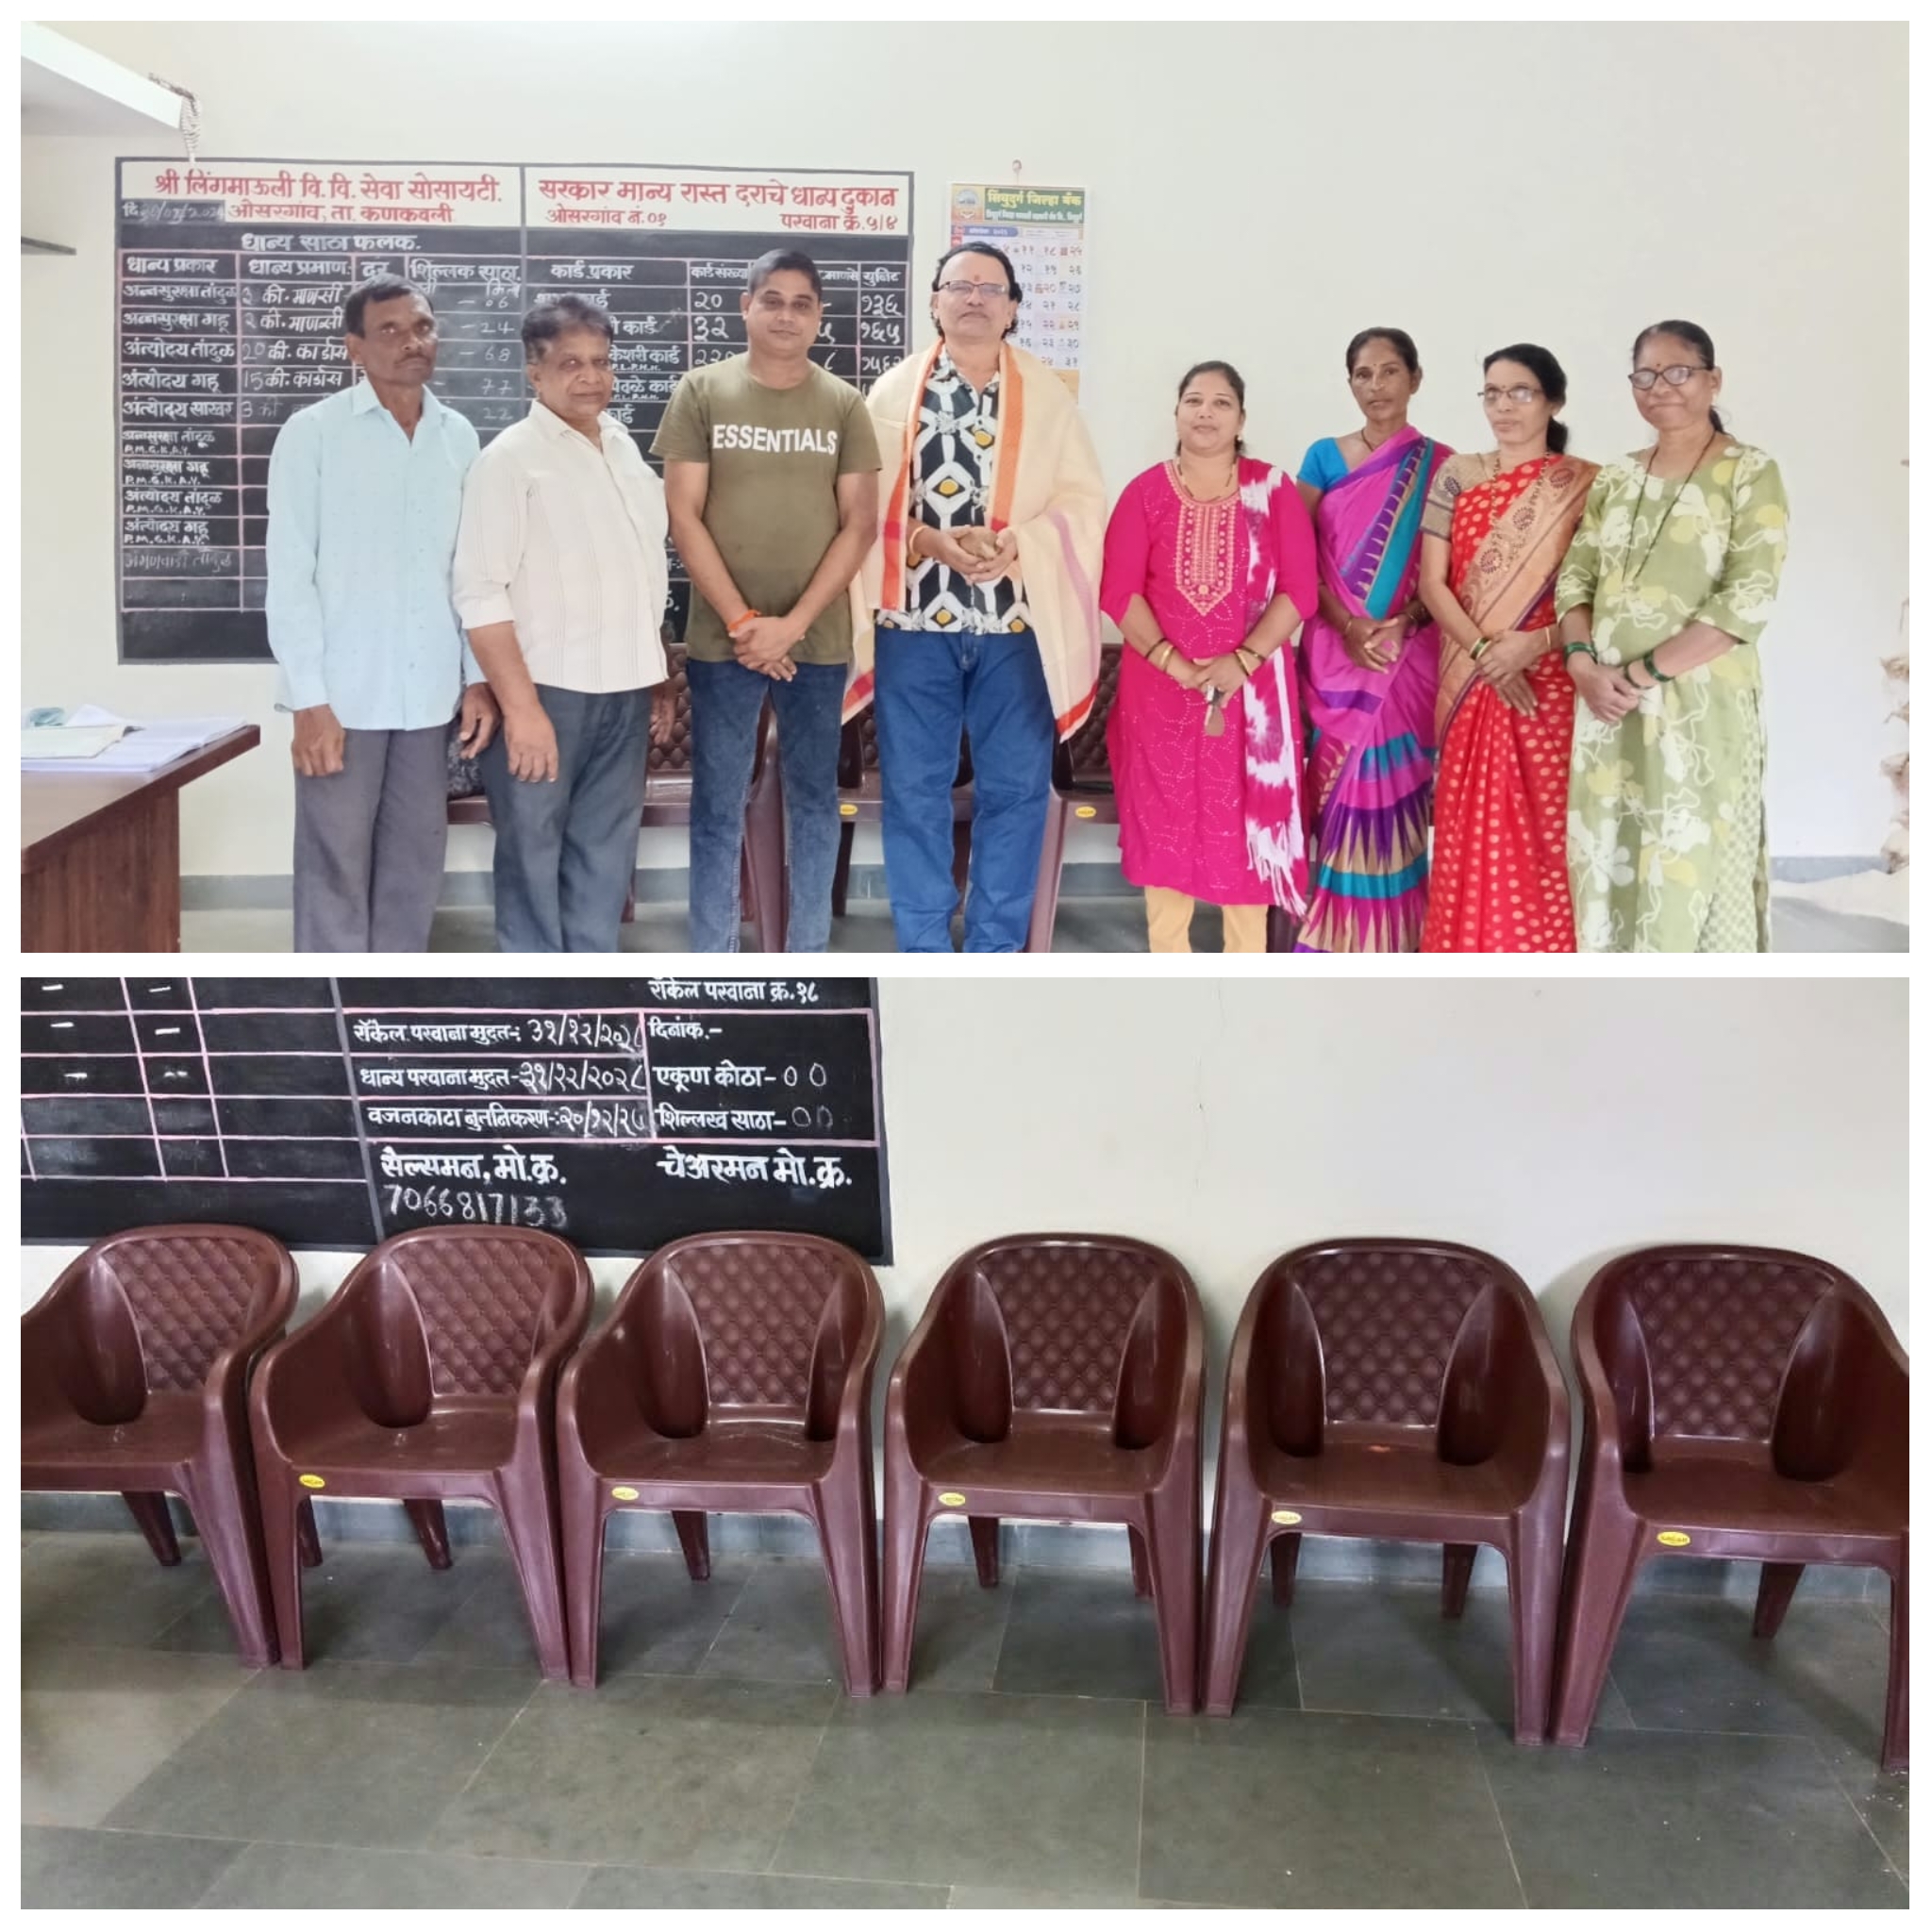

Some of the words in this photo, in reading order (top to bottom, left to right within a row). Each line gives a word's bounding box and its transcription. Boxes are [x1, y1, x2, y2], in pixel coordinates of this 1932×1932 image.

[156, 168, 180, 194] श्री
[184, 168, 296, 197] लिंगमाऊली
[299, 173, 325, 198] वि.
[328, 173, 356, 199] वि.
[360, 173, 404, 200] सेवा
[408, 172, 502, 202] सोसायटी.
[538, 179, 613, 200] सरकार
[616, 181, 675, 202] मान्य
[680, 183, 731, 204] रास्त
[735, 178, 789, 207] दराचे
[791, 186, 840, 207] धान्य
[841, 188, 899, 214] दुकान
[360, 203, 455, 223] कणकवली
[545, 203, 625, 225] ओसरगांव
[780, 213, 841, 229] परवाना
[242, 233, 294, 251] धान्य
[353, 235, 422, 251] फलक.
[126, 257, 172, 274] धान्य
[174, 258, 219, 274] प्रकार
[248, 258, 293, 275] धान्य
[409, 258, 475, 280] शिल्लक
[551, 259, 586, 278] कार्ड
[586, 265, 635, 279] प्रकार
[862, 267, 901, 286] युनिट
[623, 316, 658, 335] कार्ड
[694, 317, 729, 341] ३२
[123, 337, 190, 358] अंत्योदय
[649, 345, 681, 364] कार्ड
[122, 367, 189, 389] अंत्योदय
[123, 396, 190, 421] अंत्योदय
[190, 401, 234, 417] साखर
[712, 424, 838, 456] ESSENTIALS
[704, 981, 766, 1001] परवाना
[410, 1024, 467, 1041] परवाना
[360, 1069, 404, 1088] धान्य
[408, 1070, 467, 1087] परवाना
[652, 1066, 711, 1093] एकूण
[367, 1107, 463, 1129] वजनकाटा
[656, 1145, 770, 1184] चेअरमन
